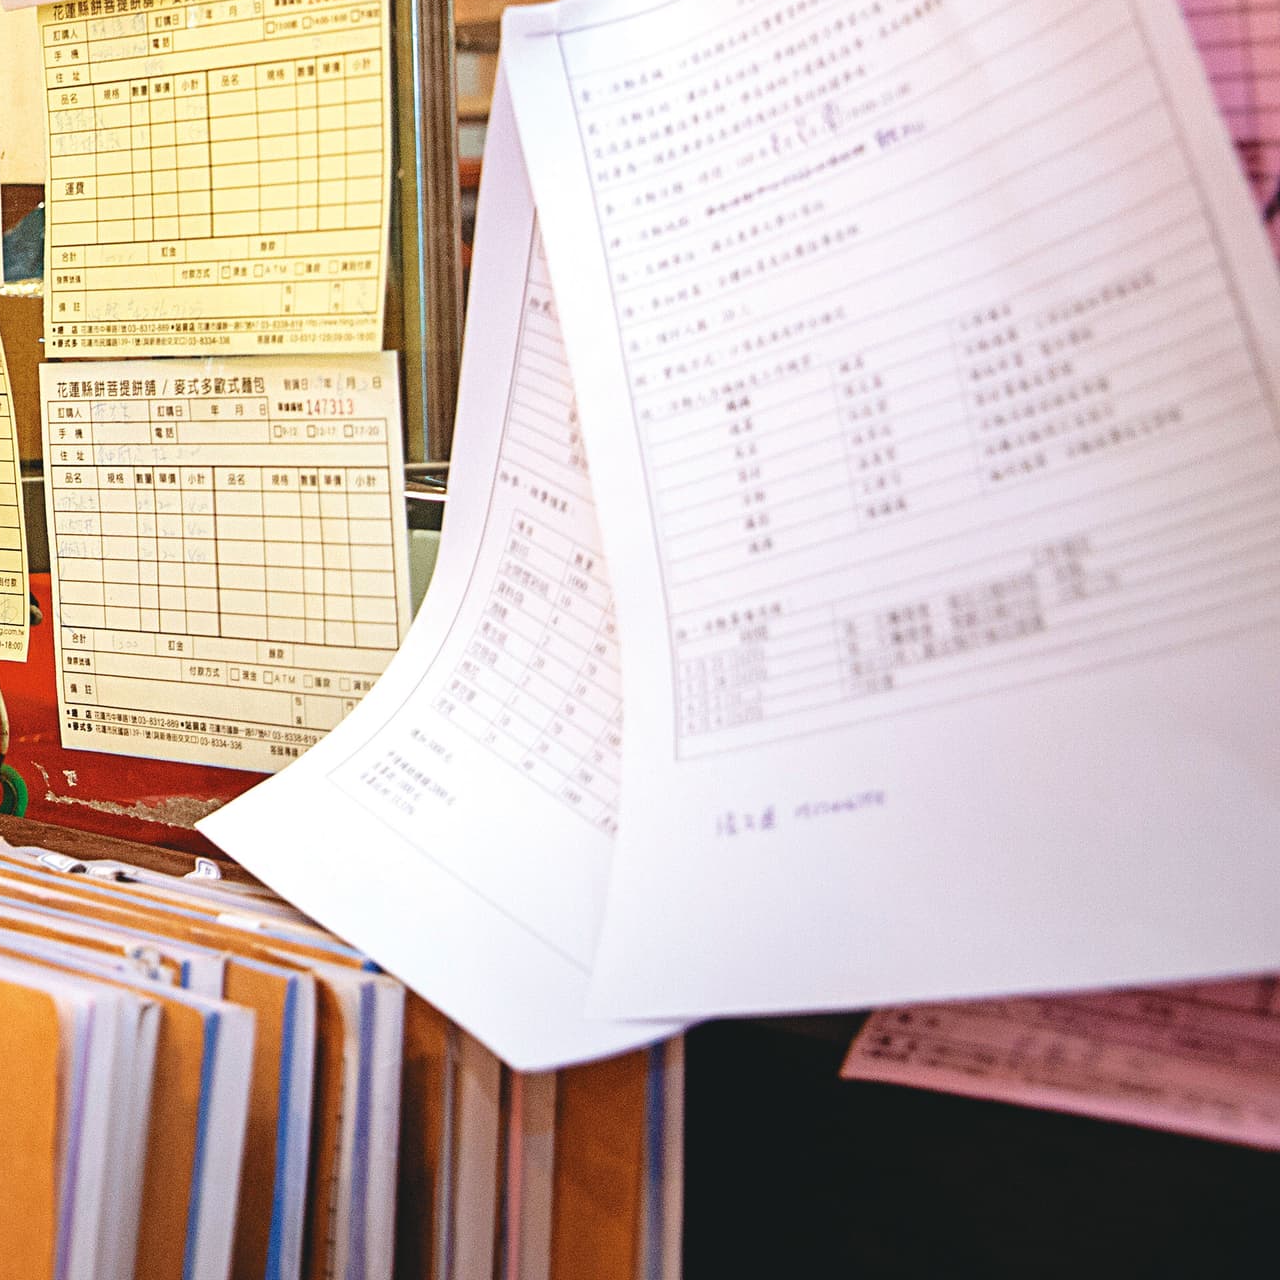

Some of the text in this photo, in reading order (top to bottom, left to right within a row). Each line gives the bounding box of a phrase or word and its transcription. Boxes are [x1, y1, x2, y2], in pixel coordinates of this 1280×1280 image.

[57, 377, 265, 398] 花蓮縣餅菩提餅舖 麥式多歐式麵包
[57, 406, 82, 419] 訂購人
[158, 405, 182, 418] 訂購日
[306, 399, 354, 416] 147313
[155, 427, 174, 439] 電話
[65, 473, 82, 484] 品名
[107, 473, 124, 484] 規格
[188, 473, 205, 485] 小計
[228, 474, 245, 485] 品名
[356, 475, 376, 487] 小計
